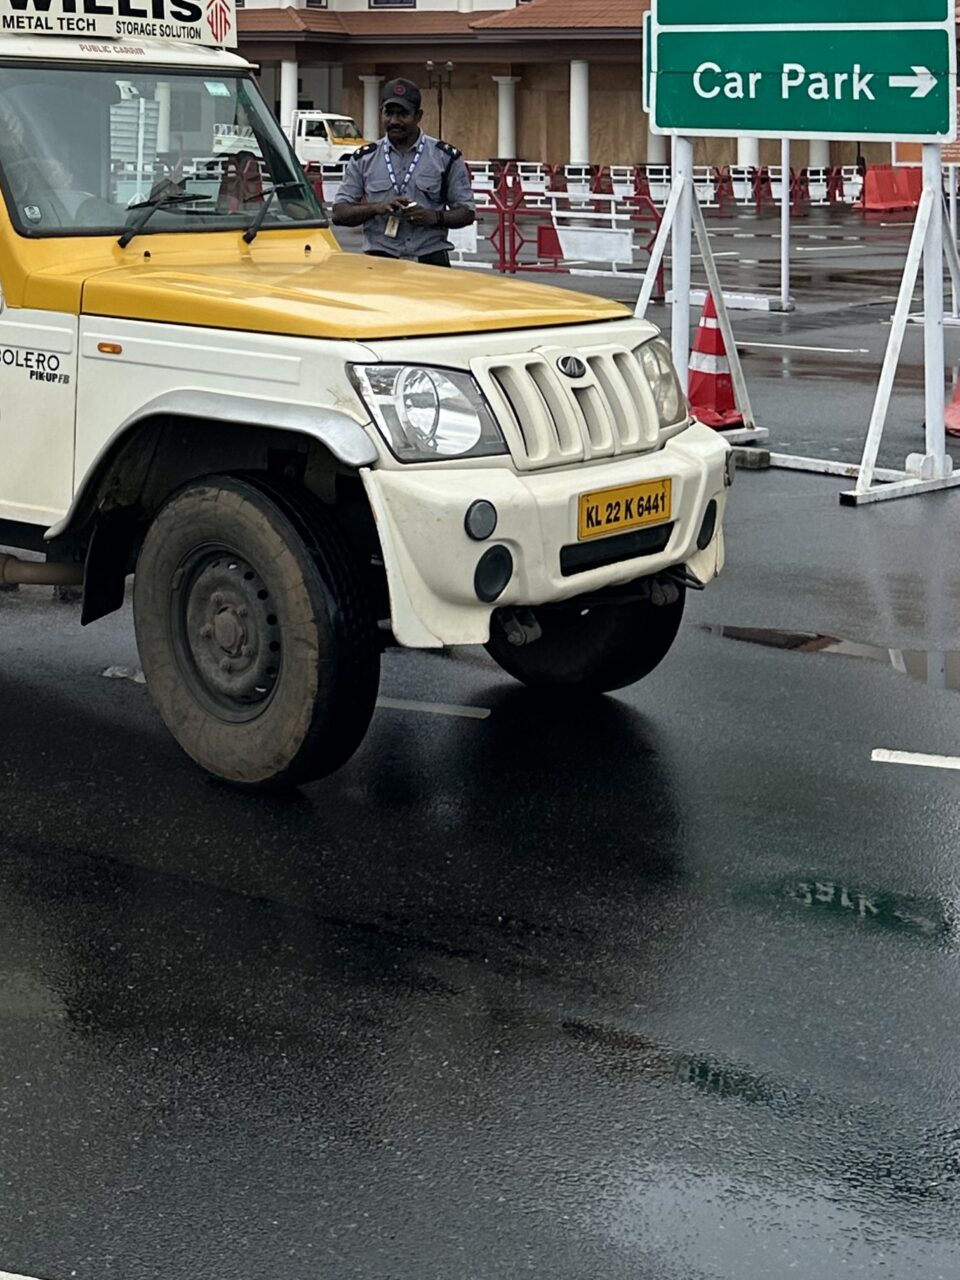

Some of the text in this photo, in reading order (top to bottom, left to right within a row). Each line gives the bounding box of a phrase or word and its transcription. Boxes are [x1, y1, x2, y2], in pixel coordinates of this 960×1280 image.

[2, 15, 201, 40] METAL TECH STORAGE SOLUTION
[79, 43, 111, 54] PUBLIC
[692, 61, 876, 101] Car Park
[586, 492, 666, 528] KL 22 K 6441
